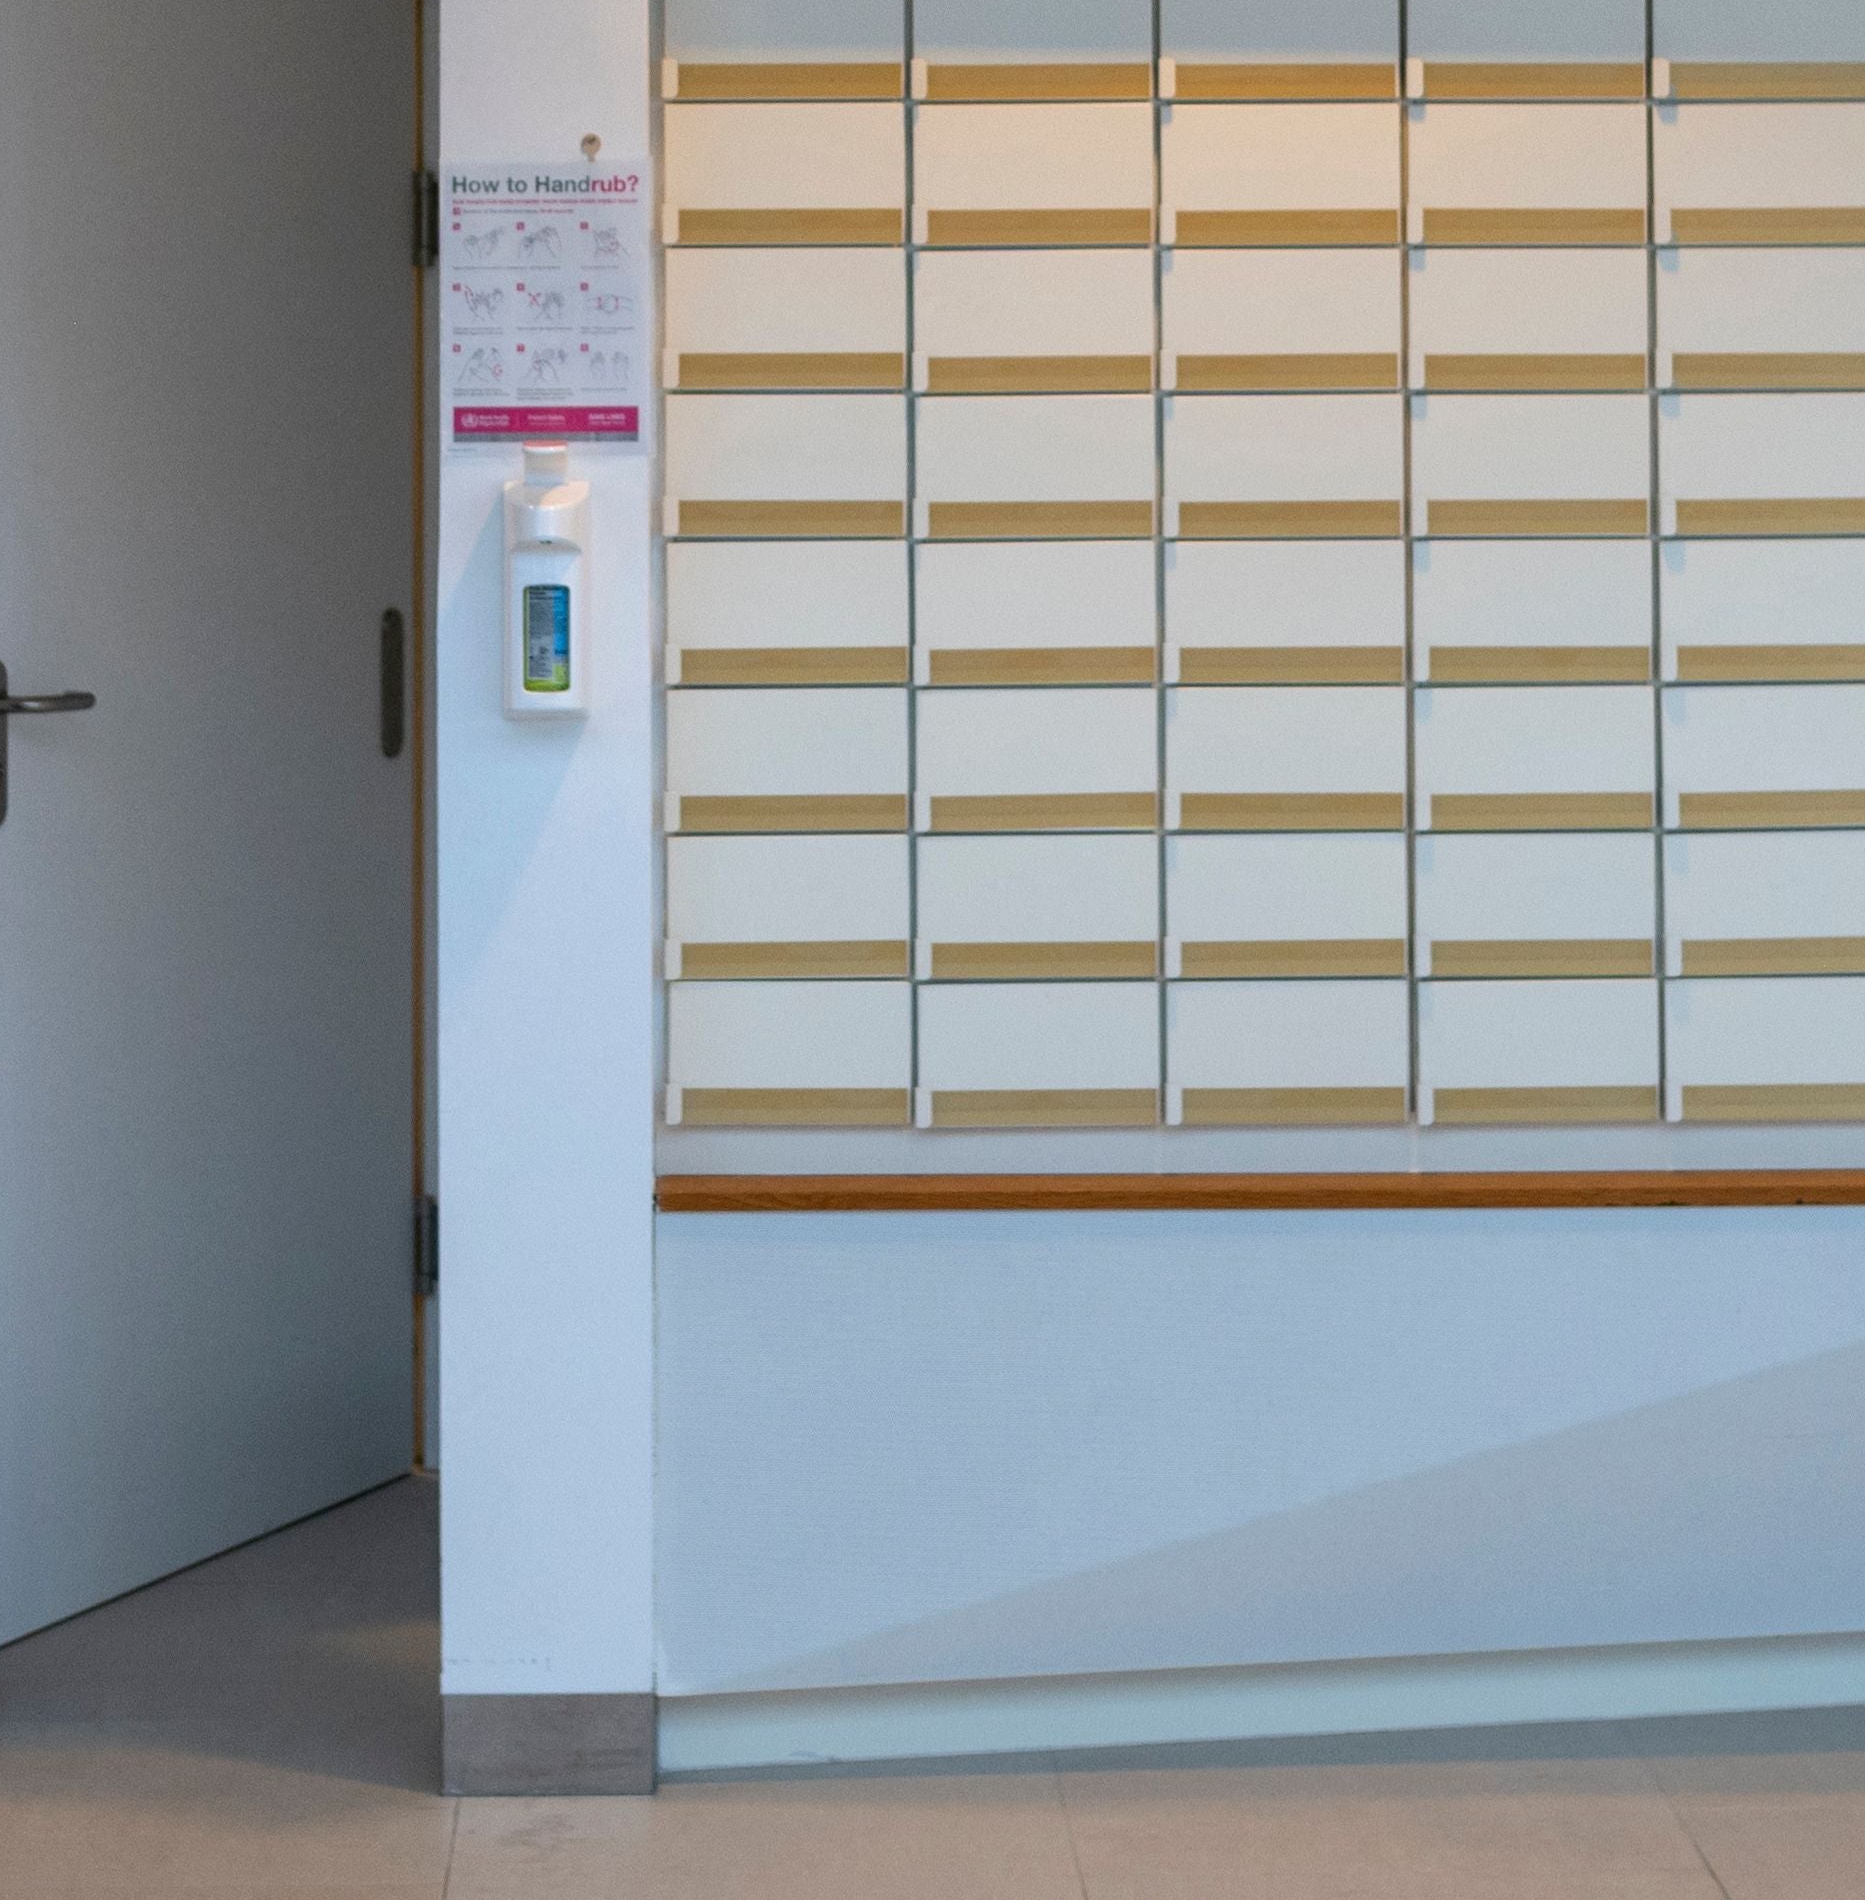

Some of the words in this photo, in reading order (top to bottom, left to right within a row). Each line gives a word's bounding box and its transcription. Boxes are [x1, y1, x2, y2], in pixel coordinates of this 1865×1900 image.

[452, 176, 500, 193] How
[508, 177, 527, 193] to
[535, 175, 639, 193] Handrub?
